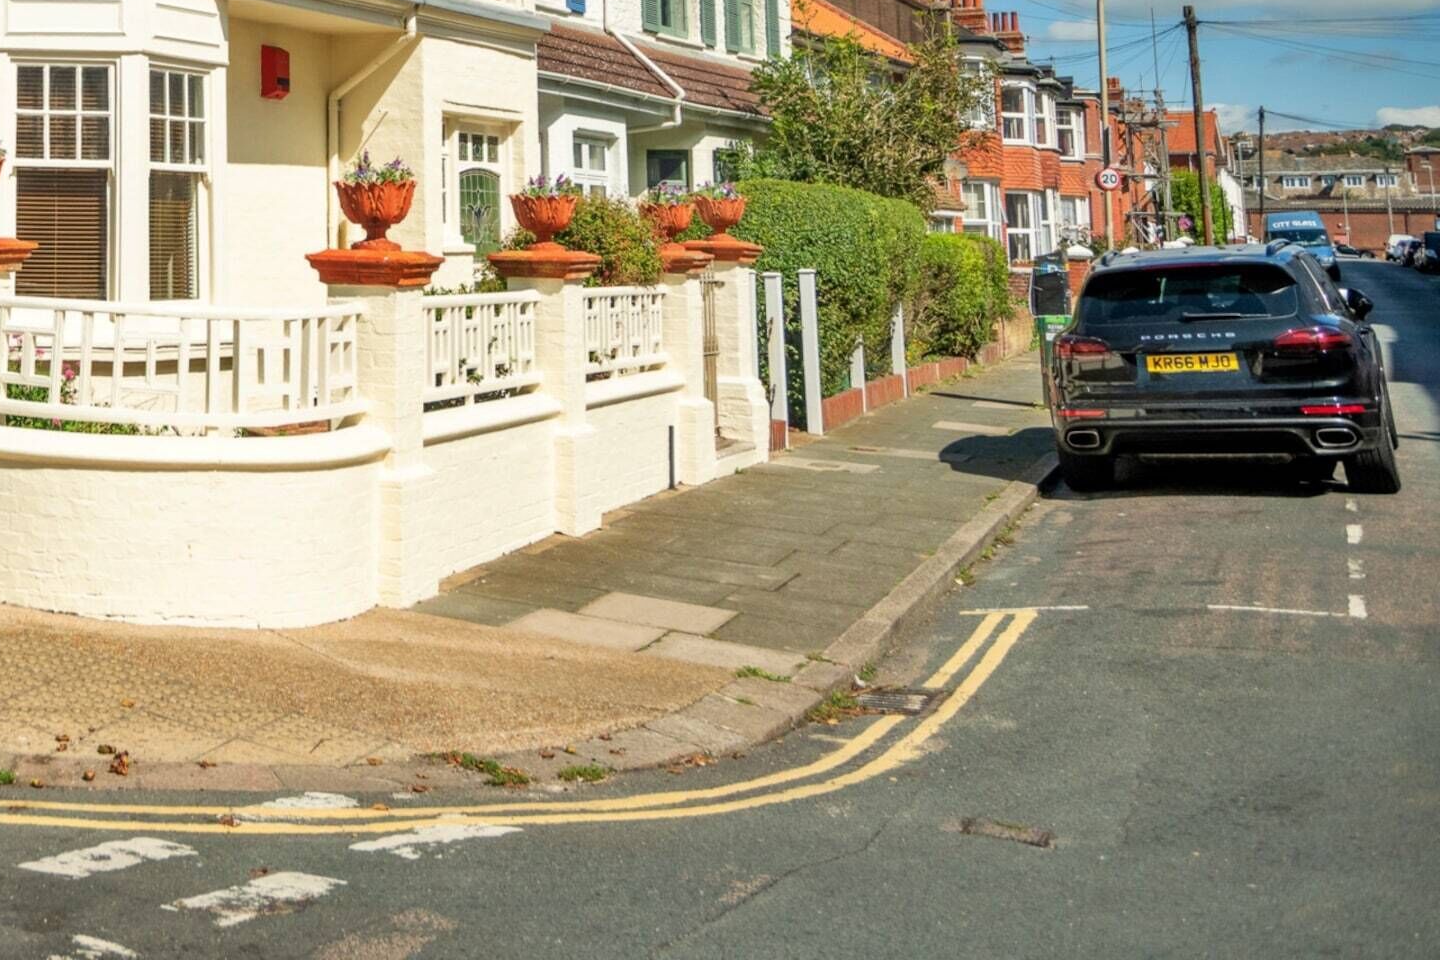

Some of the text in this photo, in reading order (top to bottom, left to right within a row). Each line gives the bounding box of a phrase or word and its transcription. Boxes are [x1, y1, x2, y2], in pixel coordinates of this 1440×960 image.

[1102, 173, 1118, 184] 20
[1140, 331, 1236, 341] PORSCHE
[1152, 356, 1195, 370] KR66
